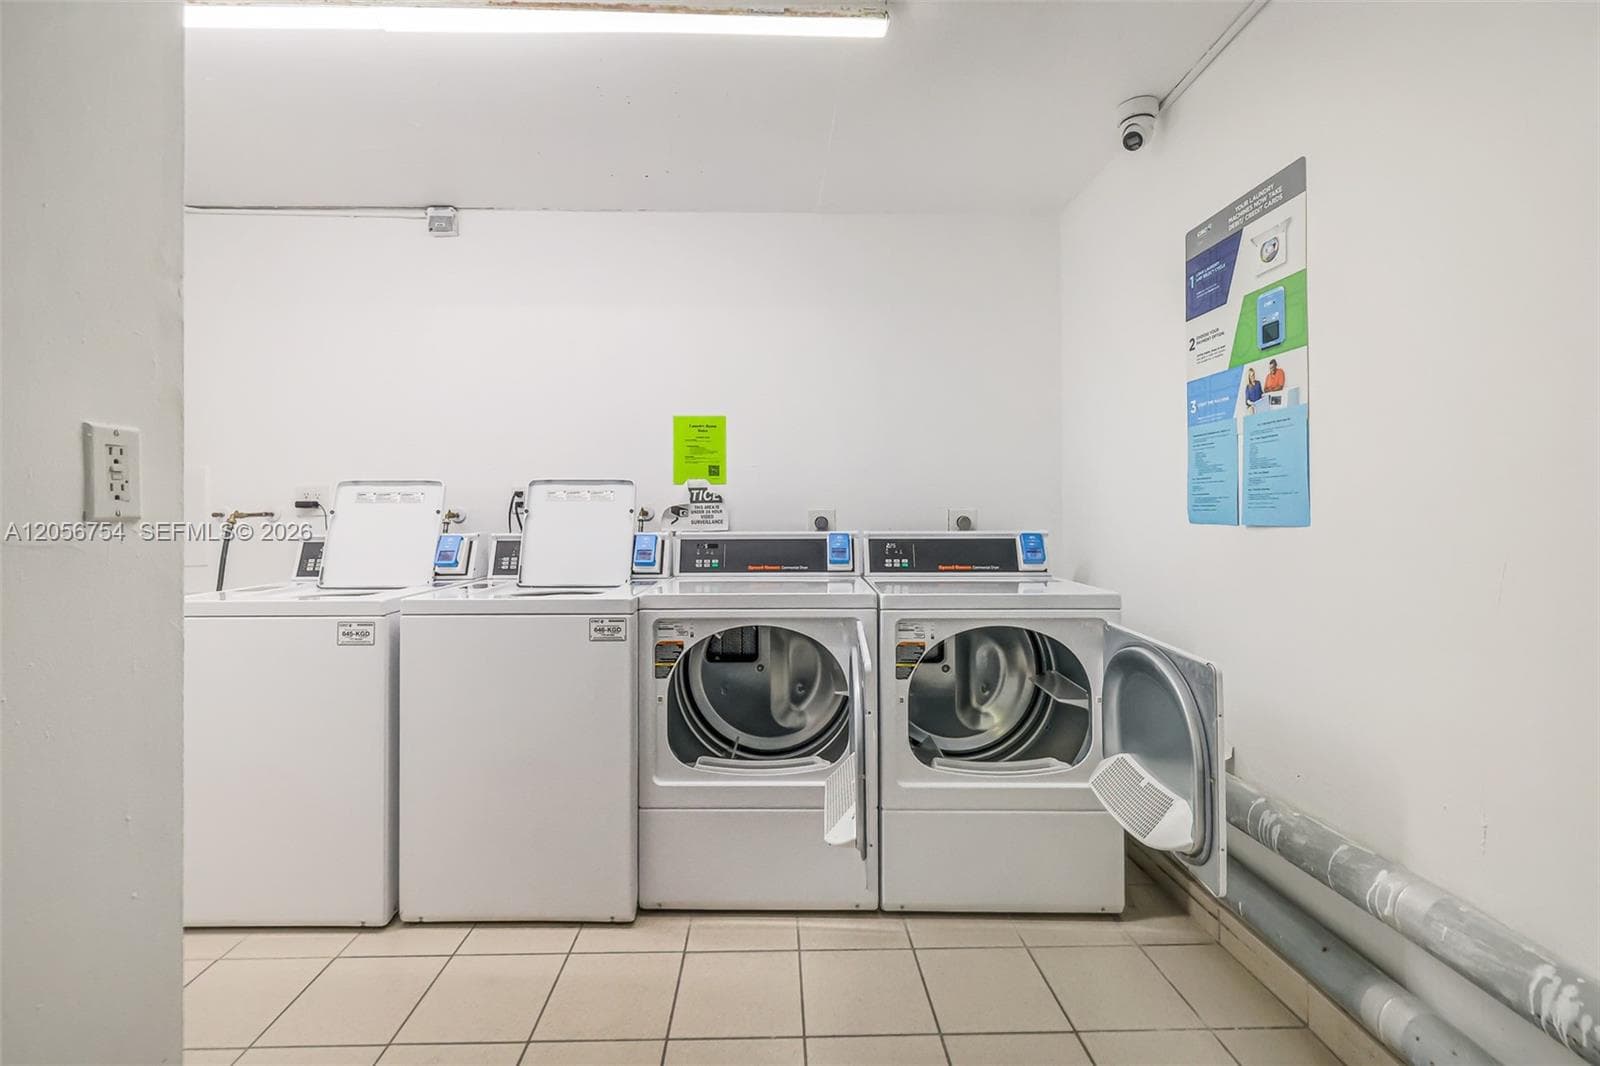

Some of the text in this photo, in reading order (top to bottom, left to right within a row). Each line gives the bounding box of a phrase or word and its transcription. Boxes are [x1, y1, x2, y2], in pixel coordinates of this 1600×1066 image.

[1249, 184, 1275, 204] LAUNDRY
[1227, 206, 1253, 223] MACHINES
[1268, 185, 1283, 201] TAKE
[1244, 206, 1264, 222] CREDIT
[1263, 194, 1284, 210] CARDS
[1189, 275, 1195, 289] 1
[1188, 337, 1196, 352] 2
[1190, 400, 1197, 414] 3
